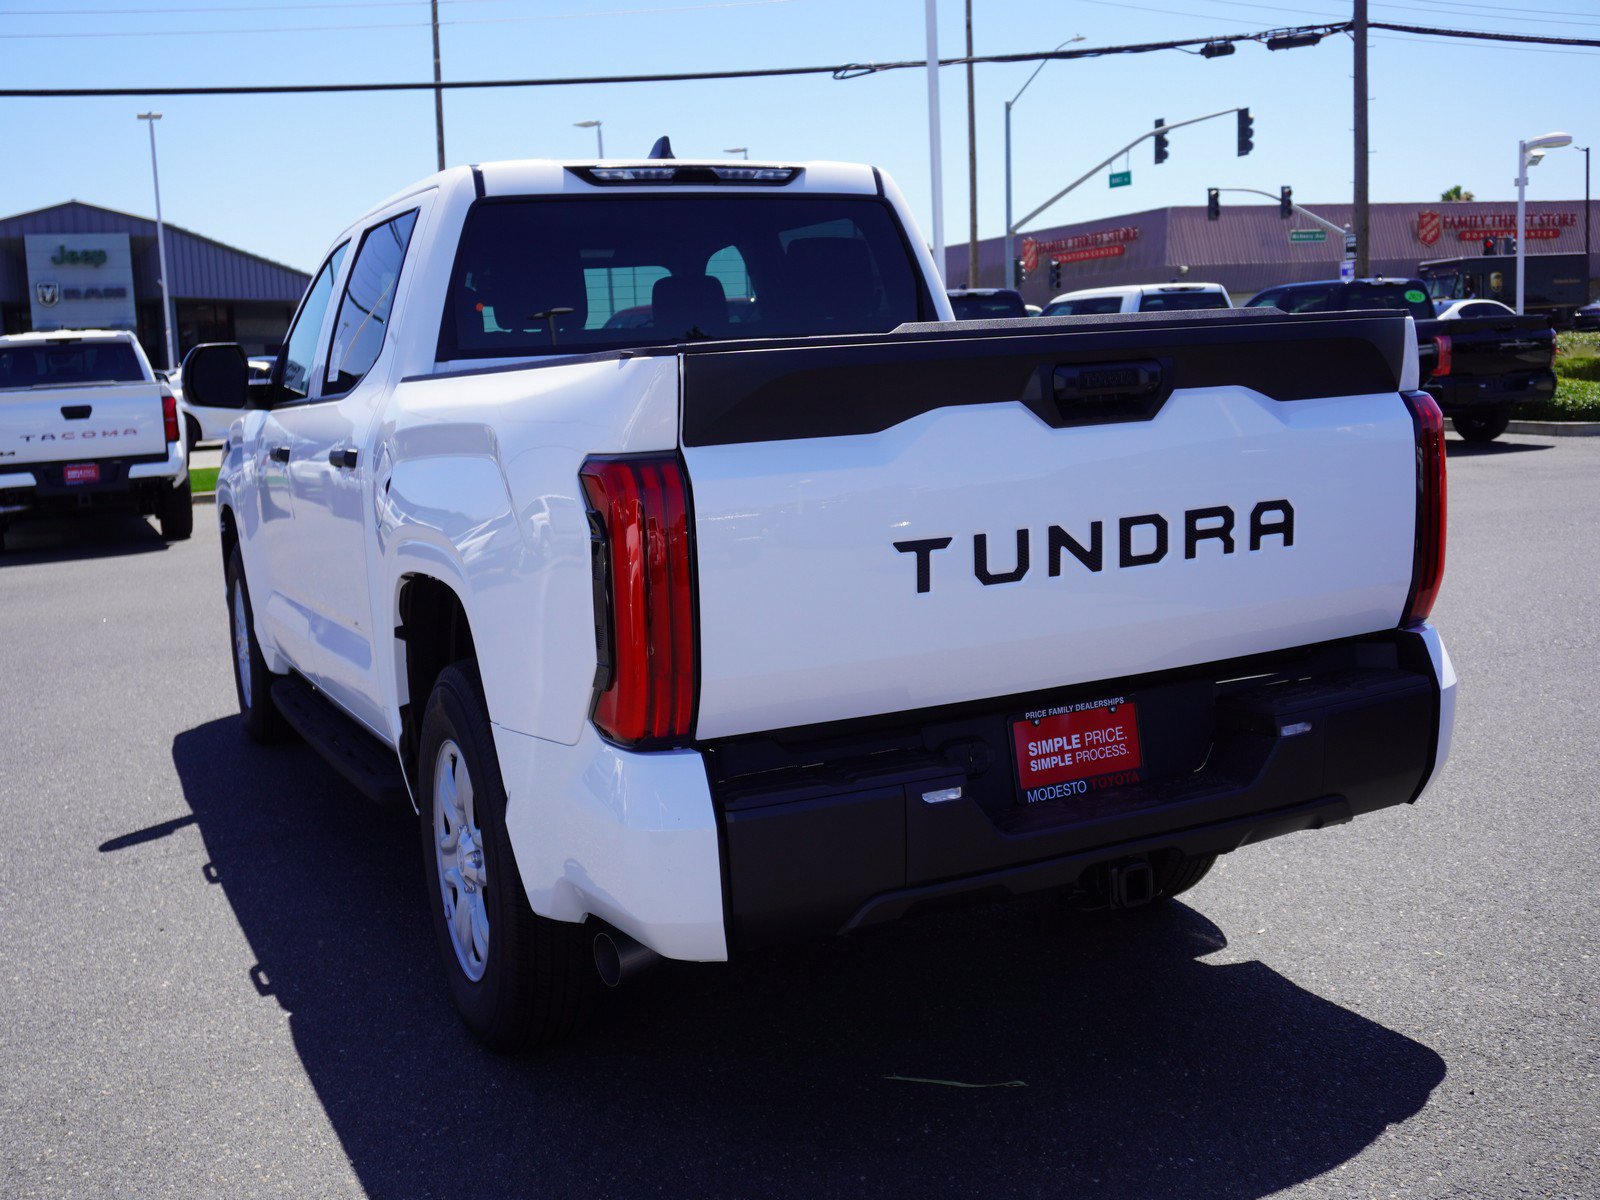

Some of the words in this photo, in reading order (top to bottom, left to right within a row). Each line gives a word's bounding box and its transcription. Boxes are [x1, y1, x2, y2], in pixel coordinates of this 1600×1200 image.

[1442, 214, 1487, 230] FAMILY
[1491, 213, 1536, 228] THRFT
[1539, 212, 1577, 228] STORE
[50, 244, 107, 269] Jeep
[19, 428, 138, 442] TACOMA
[892, 498, 1295, 594] TUNDRA
[1025, 709, 1047, 720] PRICE
[1048, 704, 1074, 716] FAMILY
[1075, 696, 1125, 711] DEALERSHIPS
[1028, 733, 1081, 757] SIMPLE
[1084, 725, 1128, 747] PRICE.
[1030, 753, 1073, 772] SIMPLE
[1075, 743, 1130, 764] PROCESS.
[1027, 780, 1087, 804] MODESTO
[1089, 771, 1140, 790] TOYOTA
